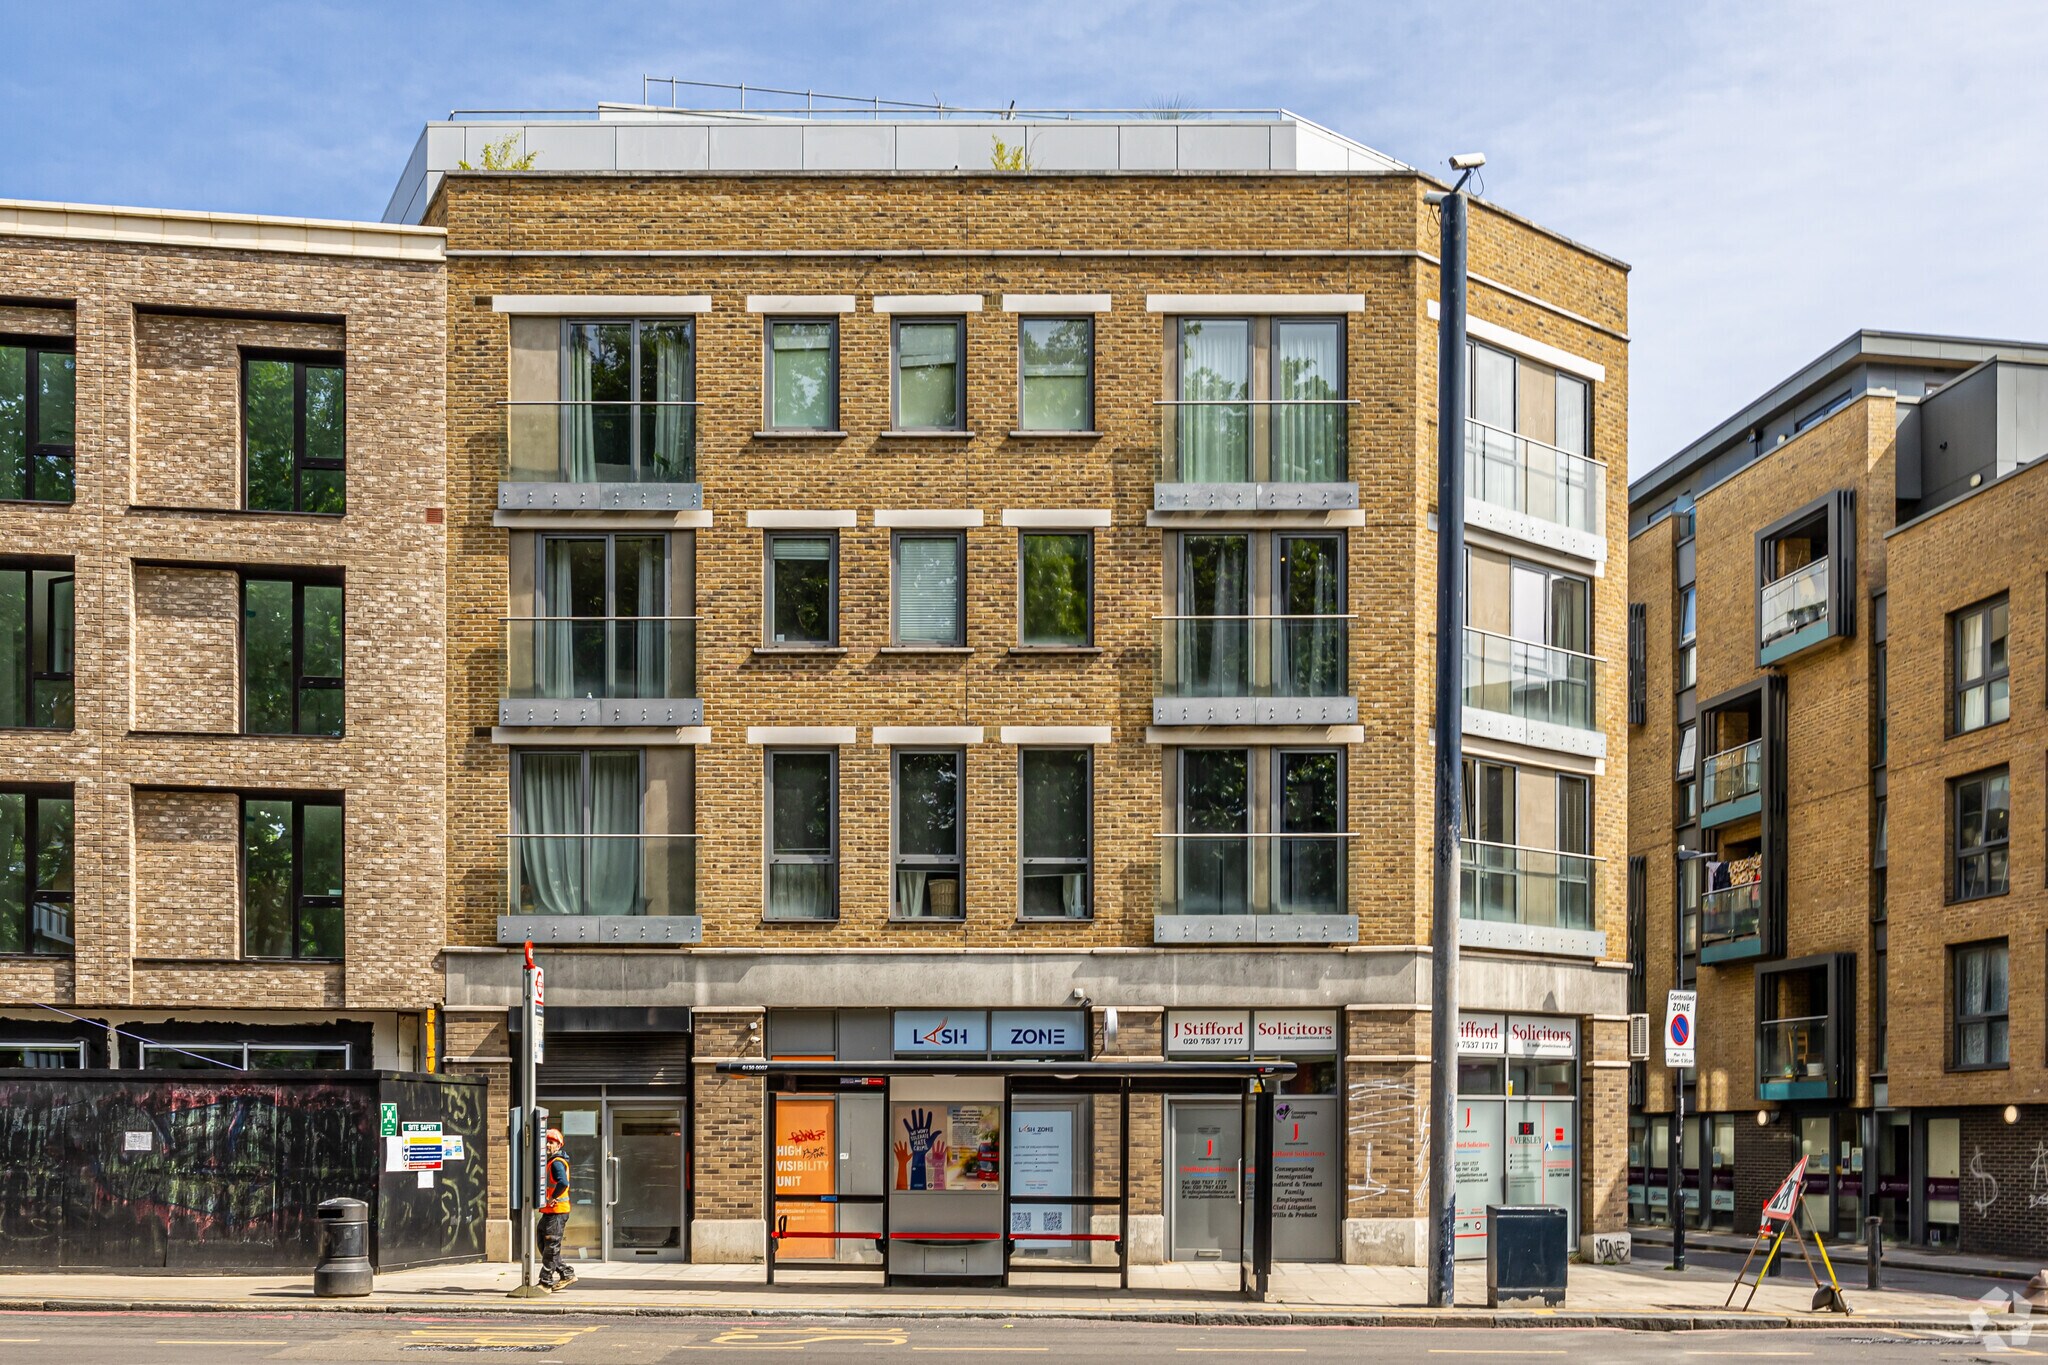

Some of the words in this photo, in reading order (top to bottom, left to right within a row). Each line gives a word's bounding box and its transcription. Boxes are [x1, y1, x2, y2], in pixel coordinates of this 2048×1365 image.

[1669, 993, 1695, 1001] Controlled
[1672, 1002, 1690, 1012] ZONE
[913, 1018, 967, 1045] LASH
[1011, 1029, 1065, 1045] ZONE
[1173, 1022, 1180, 1039] J
[1184, 1022, 1243, 1036] Stifford
[1258, 1022, 1333, 1036] Solicitors
[1460, 1021, 1498, 1039] ifford
[1511, 1023, 1572, 1042] Solicitors
[1462, 1041, 1479, 1049] 7537
[1481, 1042, 1499, 1050] 1717
[1293, 1123, 1300, 1141] J
[1206, 1138, 1213, 1157] J
[1510, 1136, 1542, 1145] EVERSLEY
[776, 1145, 802, 1156] HIGH
[776, 1160, 829, 1171] VISIBILITY
[777, 1175, 802, 1187] UNIT
[1595, 1238, 1630, 1261] MINE
